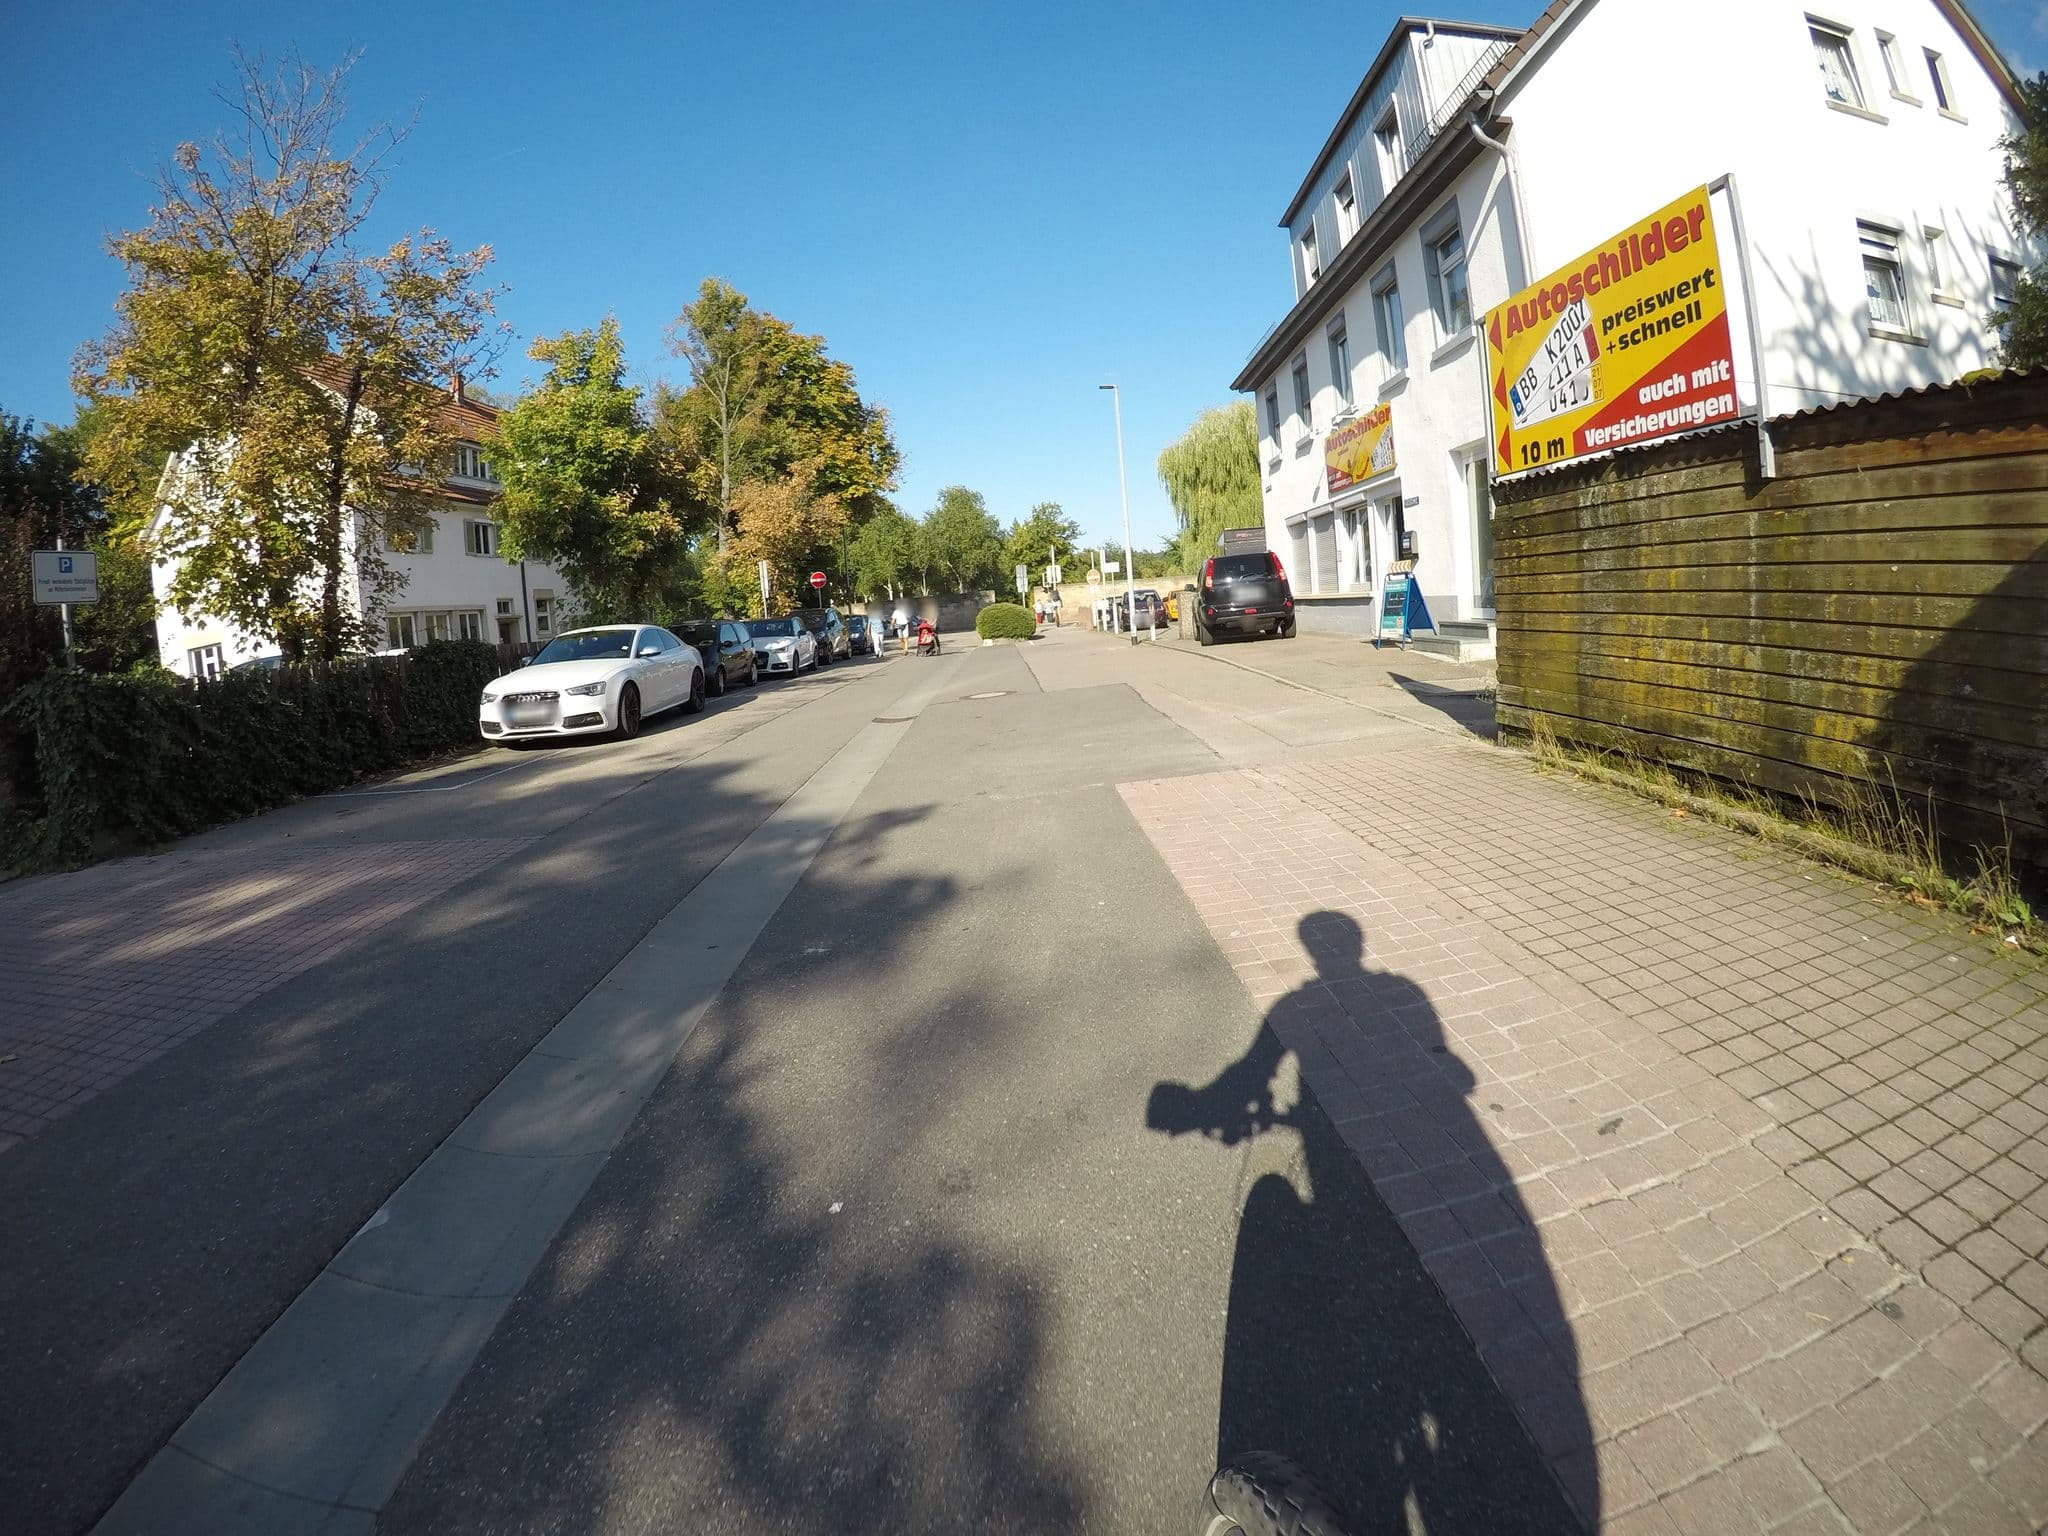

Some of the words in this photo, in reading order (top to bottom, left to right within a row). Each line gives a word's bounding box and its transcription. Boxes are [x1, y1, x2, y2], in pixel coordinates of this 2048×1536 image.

[1506, 204, 1705, 339] Autoschilder
[1602, 268, 1716, 336] preiswert
[1519, 367, 1538, 401] BB
[1639, 373, 1686, 405] auch
[1691, 359, 1731, 389] mit
[1585, 393, 1734, 448] Versicherungen
[1521, 441, 1541, 465] 10
[1547, 437, 1565, 459] m
